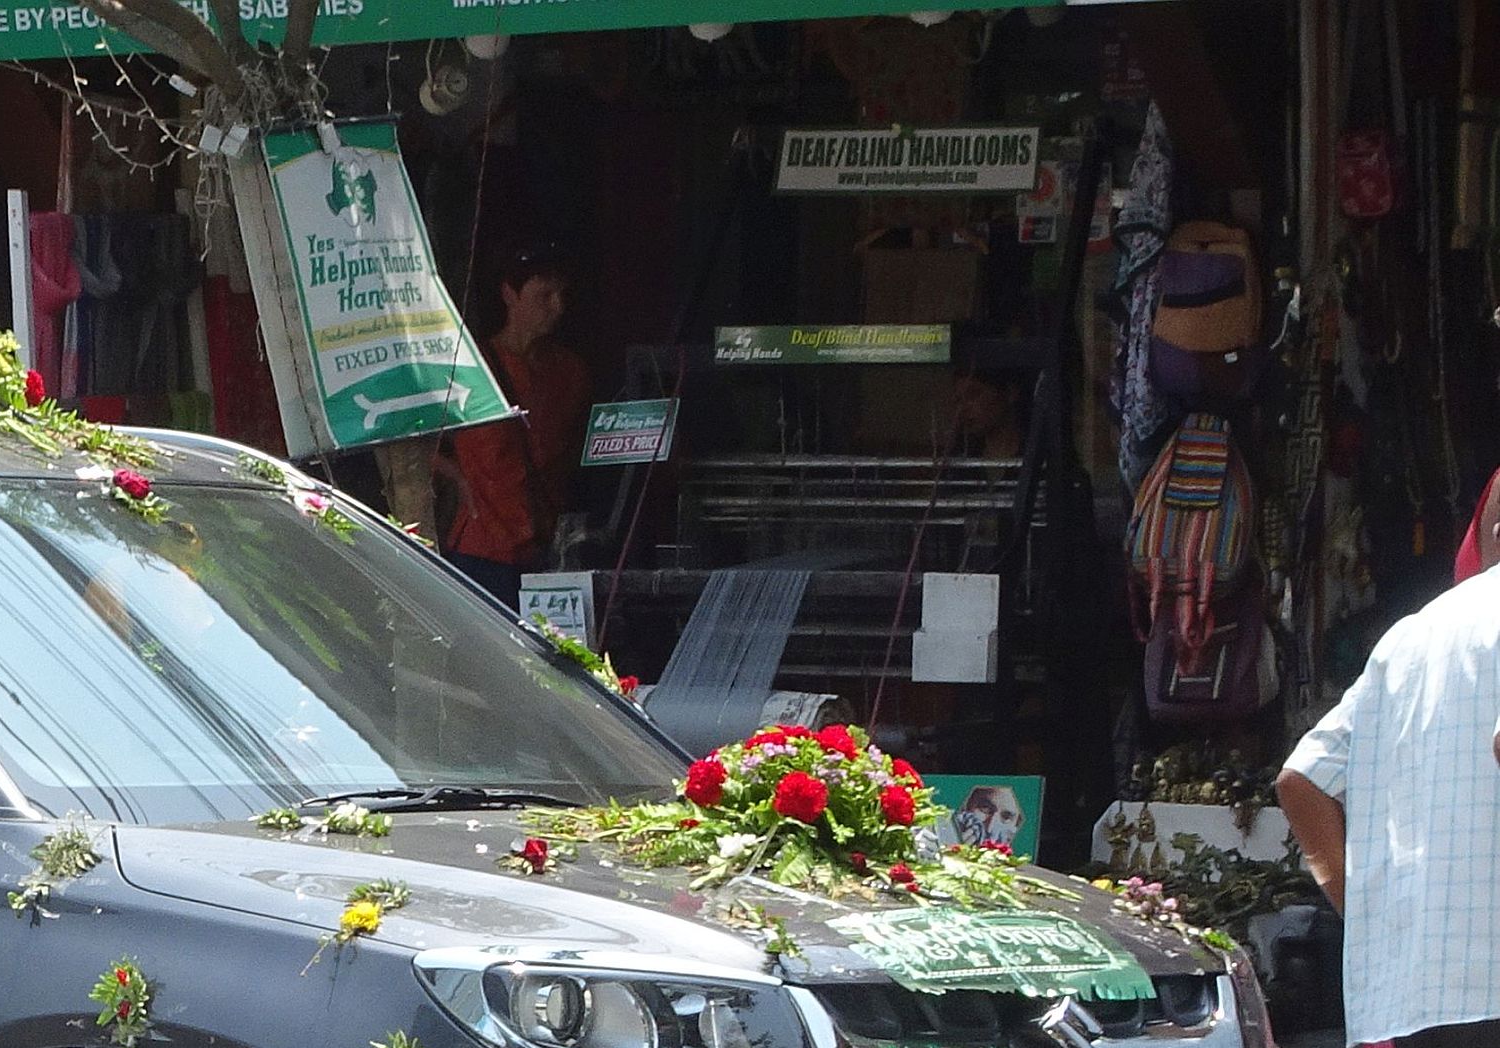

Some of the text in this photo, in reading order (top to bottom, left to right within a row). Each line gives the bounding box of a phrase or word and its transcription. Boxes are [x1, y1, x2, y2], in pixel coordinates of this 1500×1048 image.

[15, 7, 46, 31] BY
[51, 5, 106, 29] PEO
[787, 134, 1033, 167] DEAF/BLIND HANDLOOMS
[306, 233, 335, 254] Yes
[310, 245, 423, 287] Helping Hands
[337, 281, 422, 313] Handicrafts
[790, 328, 943, 348] Deaf/Blind Handlooms
[335, 345, 388, 372] FIXED
[424, 337, 454, 355] SHOP
[716, 348, 782, 361] Helping Hands
[644, 415, 666, 427] Hand
